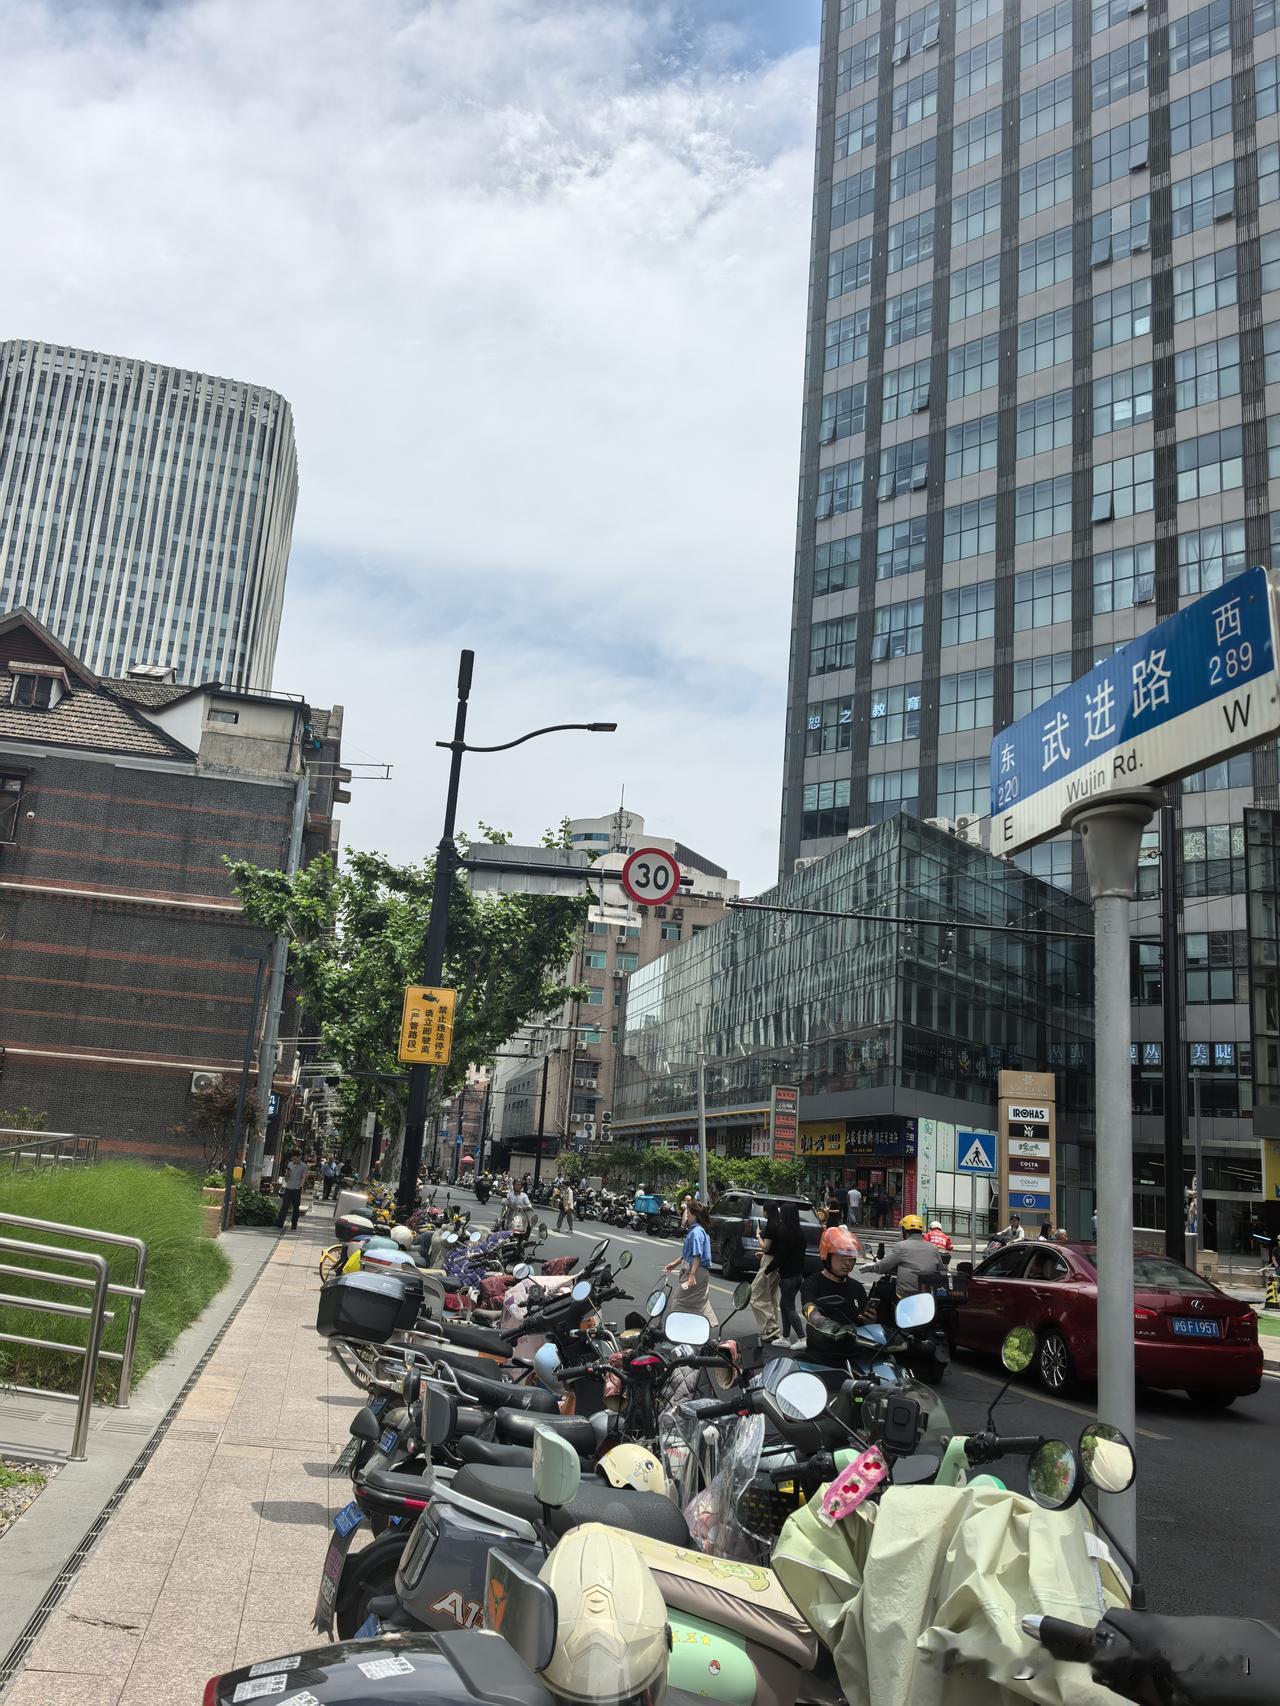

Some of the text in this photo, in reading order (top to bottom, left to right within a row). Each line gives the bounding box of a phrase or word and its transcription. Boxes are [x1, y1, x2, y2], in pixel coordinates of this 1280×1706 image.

[1212, 597, 1241, 646] 西
[1209, 641, 1252, 686] 289
[1042, 648, 1172, 772] 武进路
[1223, 694, 1251, 734] W
[1001, 743, 1015, 773] 东
[1066, 749, 1143, 803] Wujin Rd.
[998, 776, 1019, 807] 220
[1003, 815, 1014, 841] E
[635, 863, 669, 890] 30
[420, 1009, 433, 1054] 请立即驶离
[434, 1006, 448, 1059] 禁止违法停车
[1012, 1108, 1045, 1120] IROHAS
